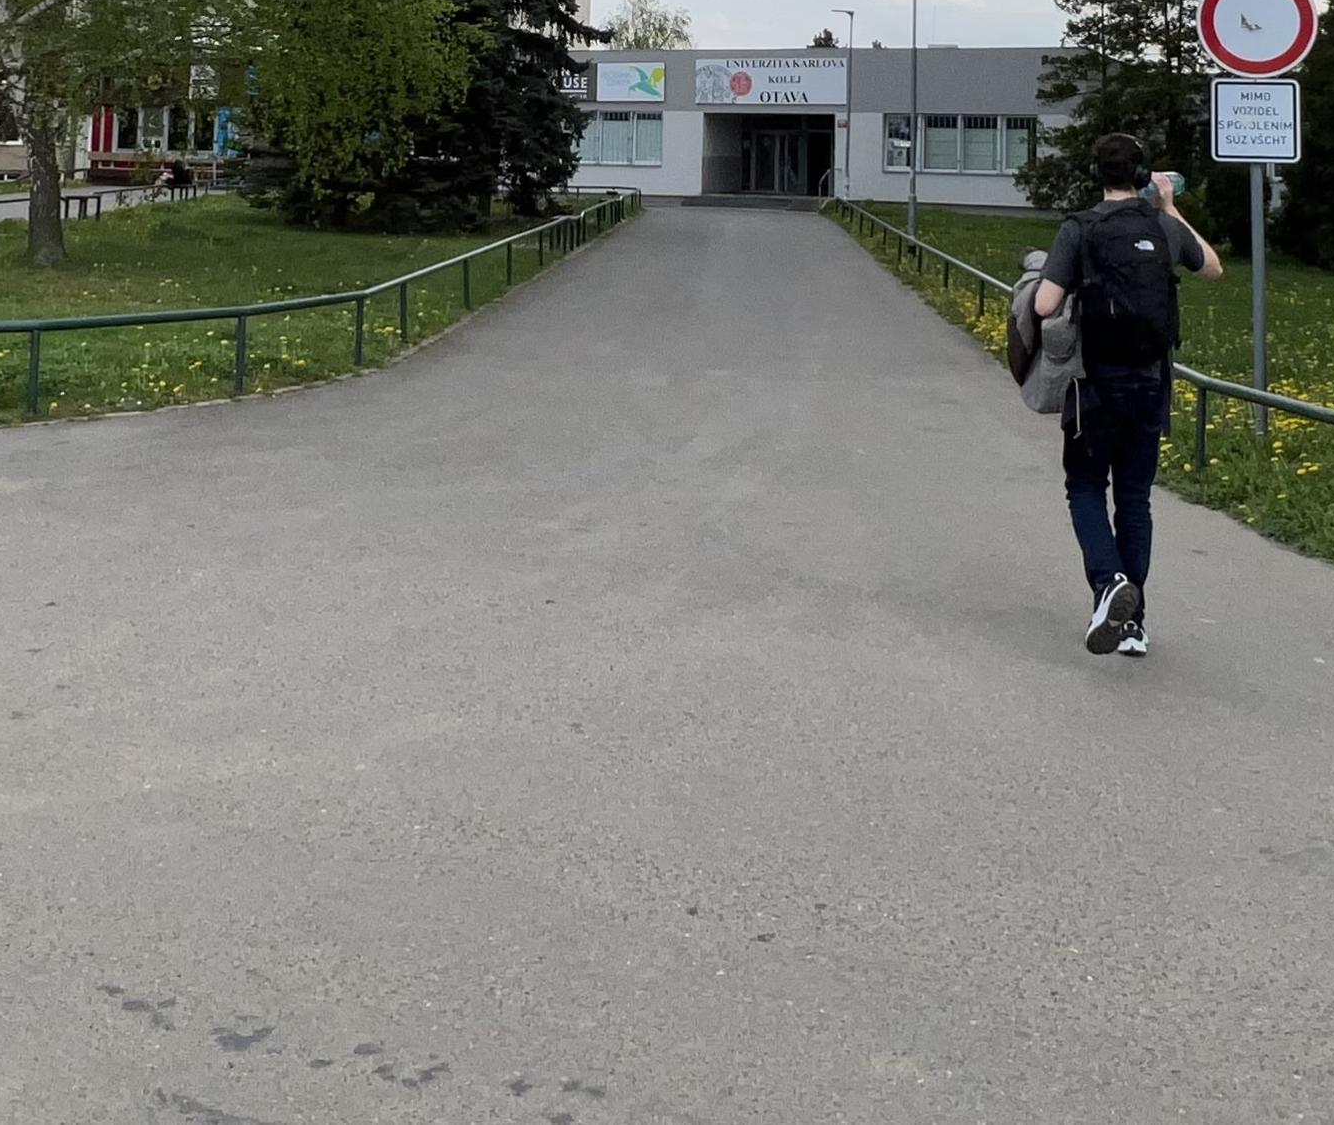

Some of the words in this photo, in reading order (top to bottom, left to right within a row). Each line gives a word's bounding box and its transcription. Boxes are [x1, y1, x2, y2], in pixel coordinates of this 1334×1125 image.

[726, 59, 791, 68] UNIVERZITA
[793, 58, 845, 68] KARLOVA
[768, 75, 801, 84] KOLEJ
[759, 90, 809, 103] OTAVA
[1240, 92, 1271, 101] MIMO
[1233, 106, 1279, 116] VOZIDEL
